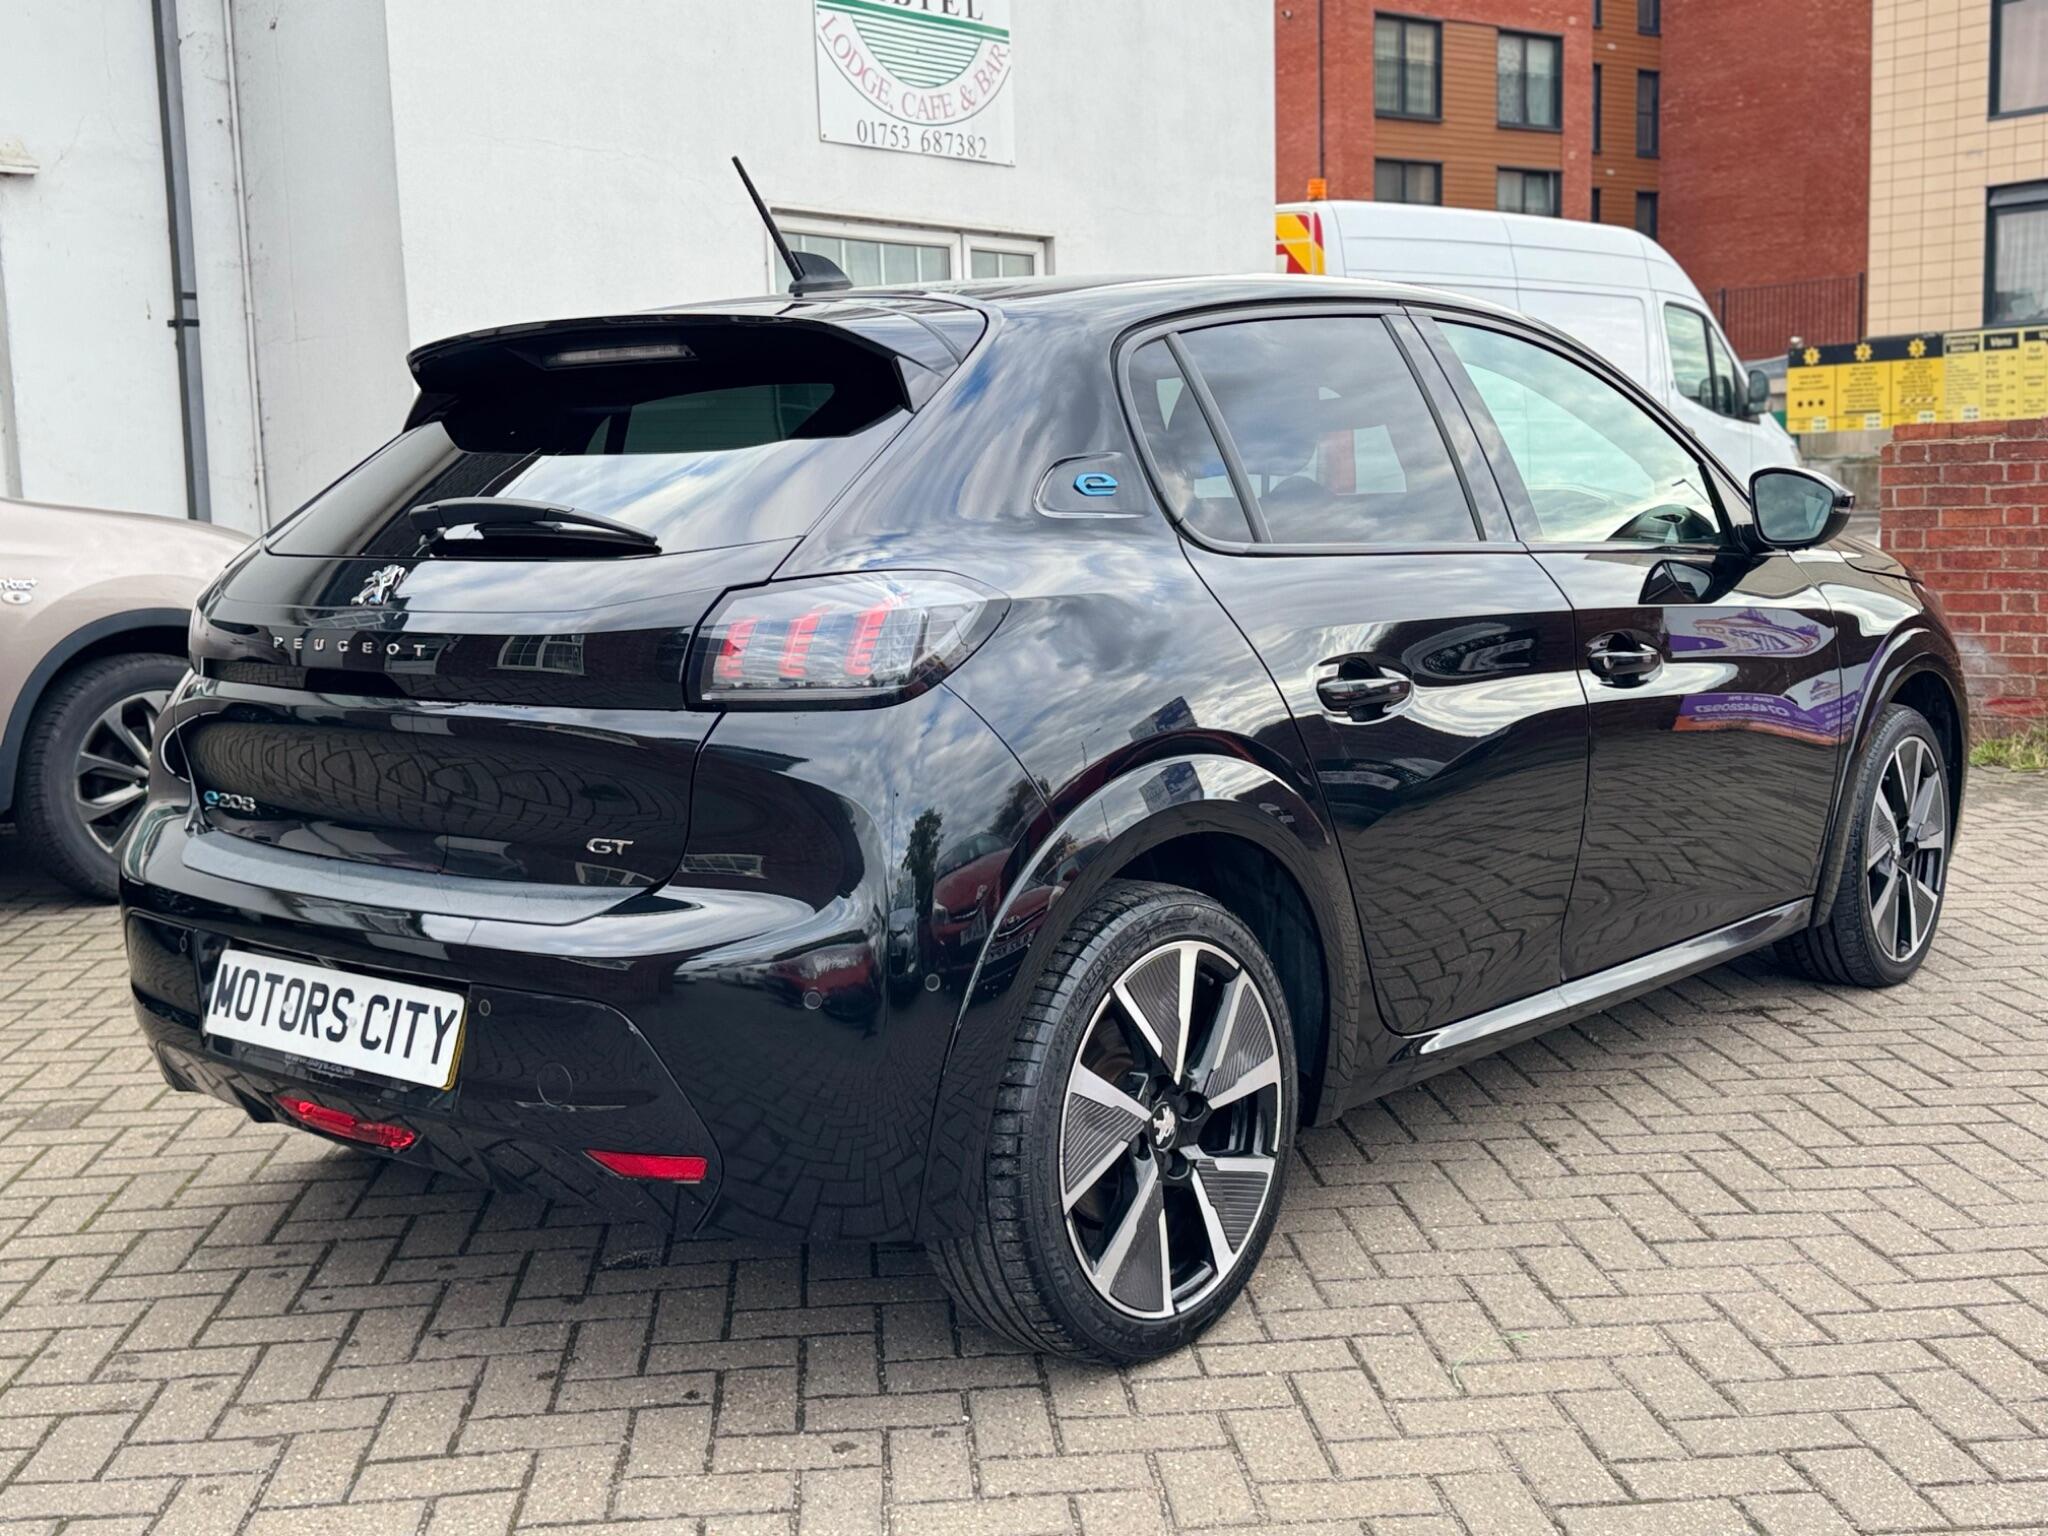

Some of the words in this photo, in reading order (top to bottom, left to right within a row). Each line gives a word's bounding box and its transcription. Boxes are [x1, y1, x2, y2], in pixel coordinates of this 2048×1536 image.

[821, 15, 895, 112] LODGE,
[901, 91, 956, 121] CAFE
[959, 84, 977, 112] &
[973, 44, 1009, 95] BAR
[856, 119, 910, 149] 01753
[920, 128, 988, 159] 687382
[273, 636, 426, 657] PEUGEOT
[586, 837, 634, 856] GT
[212, 963, 355, 1043] MOTORS
[360, 994, 458, 1065] CITY
